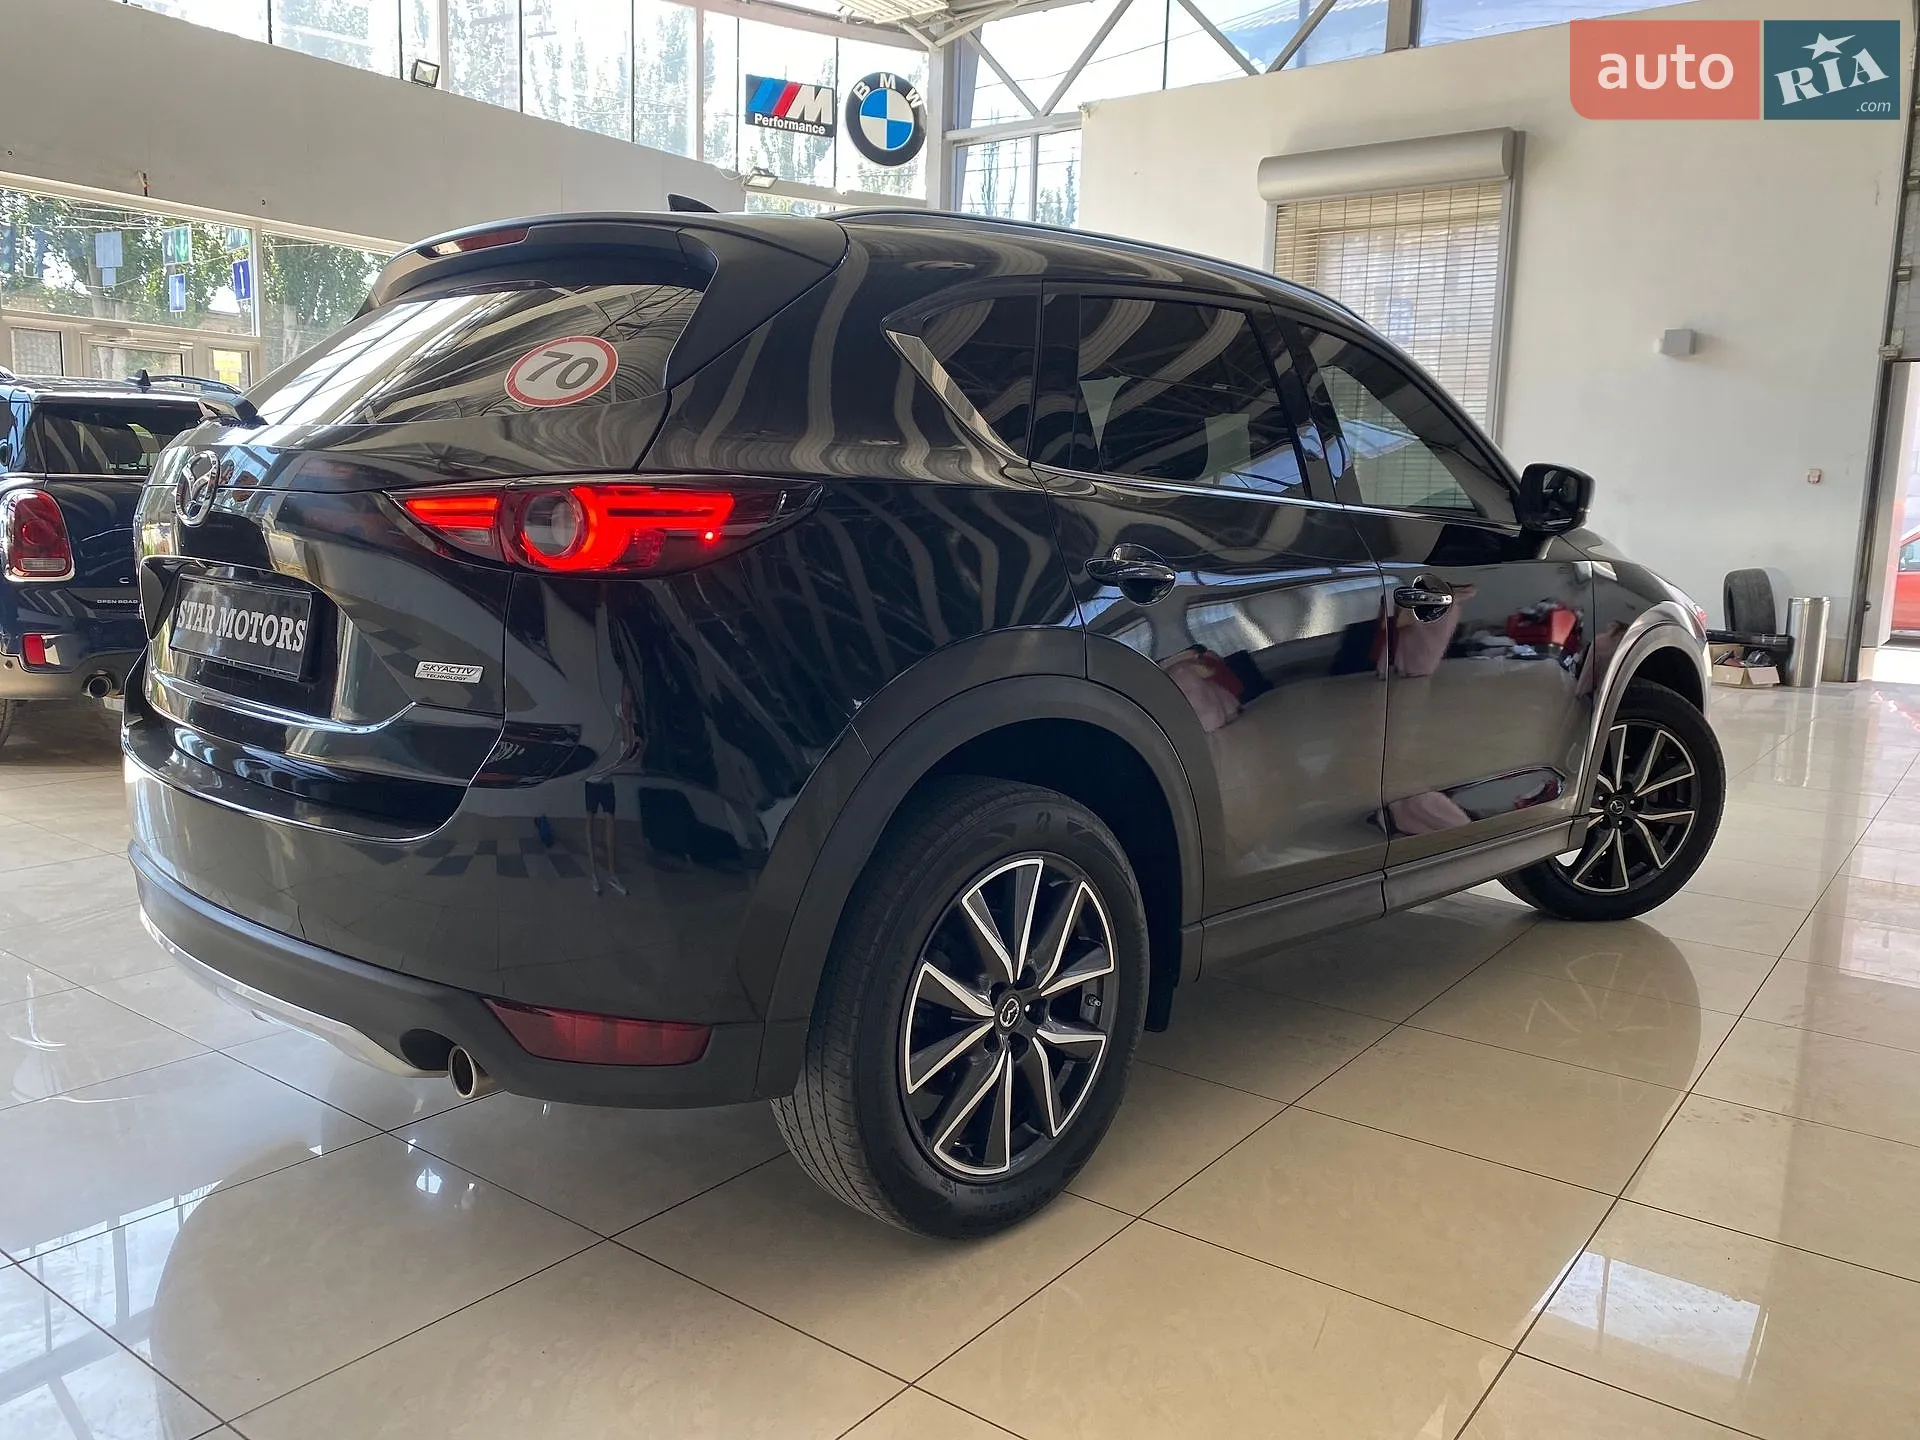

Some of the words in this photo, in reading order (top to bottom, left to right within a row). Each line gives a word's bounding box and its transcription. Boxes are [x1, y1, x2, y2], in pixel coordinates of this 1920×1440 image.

[785, 84, 834, 125] M
[852, 73, 923, 109] BMW
[754, 113, 825, 135] Performance
[525, 350, 599, 390] 70
[176, 600, 216, 634] STAR
[216, 606, 307, 653] MOTORS
[422, 664, 473, 674] SKYACTIV
